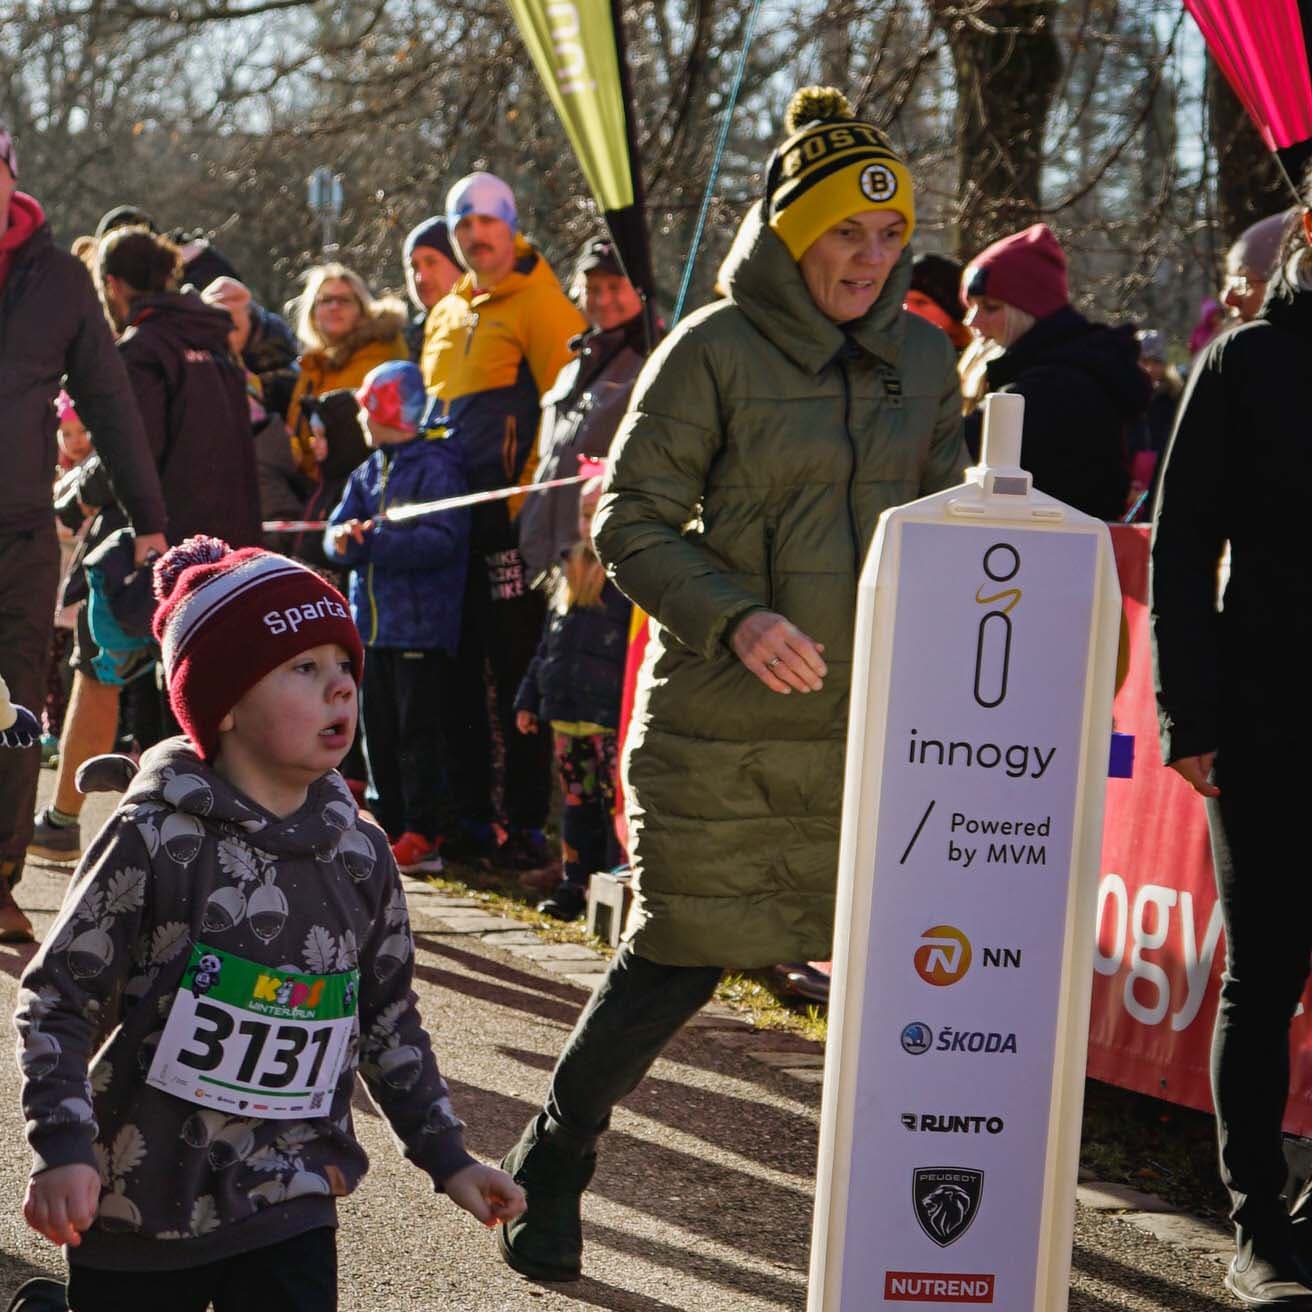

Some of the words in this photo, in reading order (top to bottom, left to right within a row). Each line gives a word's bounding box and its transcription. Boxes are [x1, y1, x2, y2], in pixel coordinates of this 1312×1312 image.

[263, 596, 347, 635] Sparta
[909, 728, 1057, 779] innogy
[951, 813, 1051, 837] Powered
[948, 840, 977, 868] by
[987, 843, 1046, 865] MVM
[983, 948, 1021, 968] NN
[176, 1001, 334, 1089] 3131
[936, 1026, 1018, 1054] ŠKODA
[920, 1114, 1004, 1134] RUNTO
[919, 1173, 977, 1183] PEUGEOT
[891, 1278, 989, 1297] NUTREND
